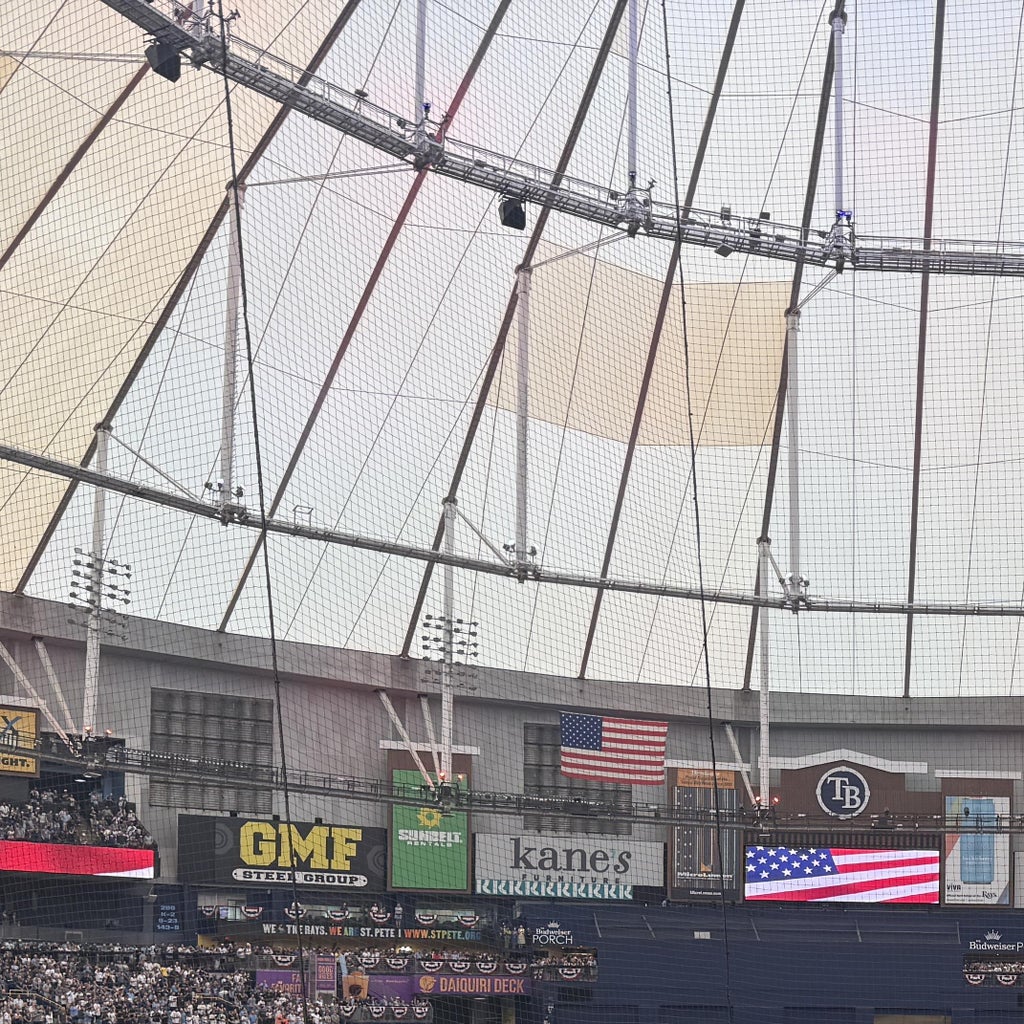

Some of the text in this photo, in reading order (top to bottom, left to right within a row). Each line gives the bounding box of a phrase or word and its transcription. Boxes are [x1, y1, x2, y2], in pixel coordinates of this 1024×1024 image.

[827, 777, 861, 808] TB
[398, 829, 463, 843] SUNBELT
[240, 821, 362, 871] GMF
[304, 873, 359, 885] GROUP
[522, 875, 620, 884] FURNITURE
[263, 924, 276, 934] WE
[305, 925, 328, 935] RAYS.
[329, 926, 342, 936] WE
[343, 927, 359, 936] ARE
[360, 927, 373, 937] ST.
[375, 928, 395, 938] PETE
[404, 929, 480, 940] WWW.STPETE.ORG
[532, 934, 573, 944] PORCH
[969, 941, 1016, 951] Budweiser
[494, 978, 524, 993] DECK
